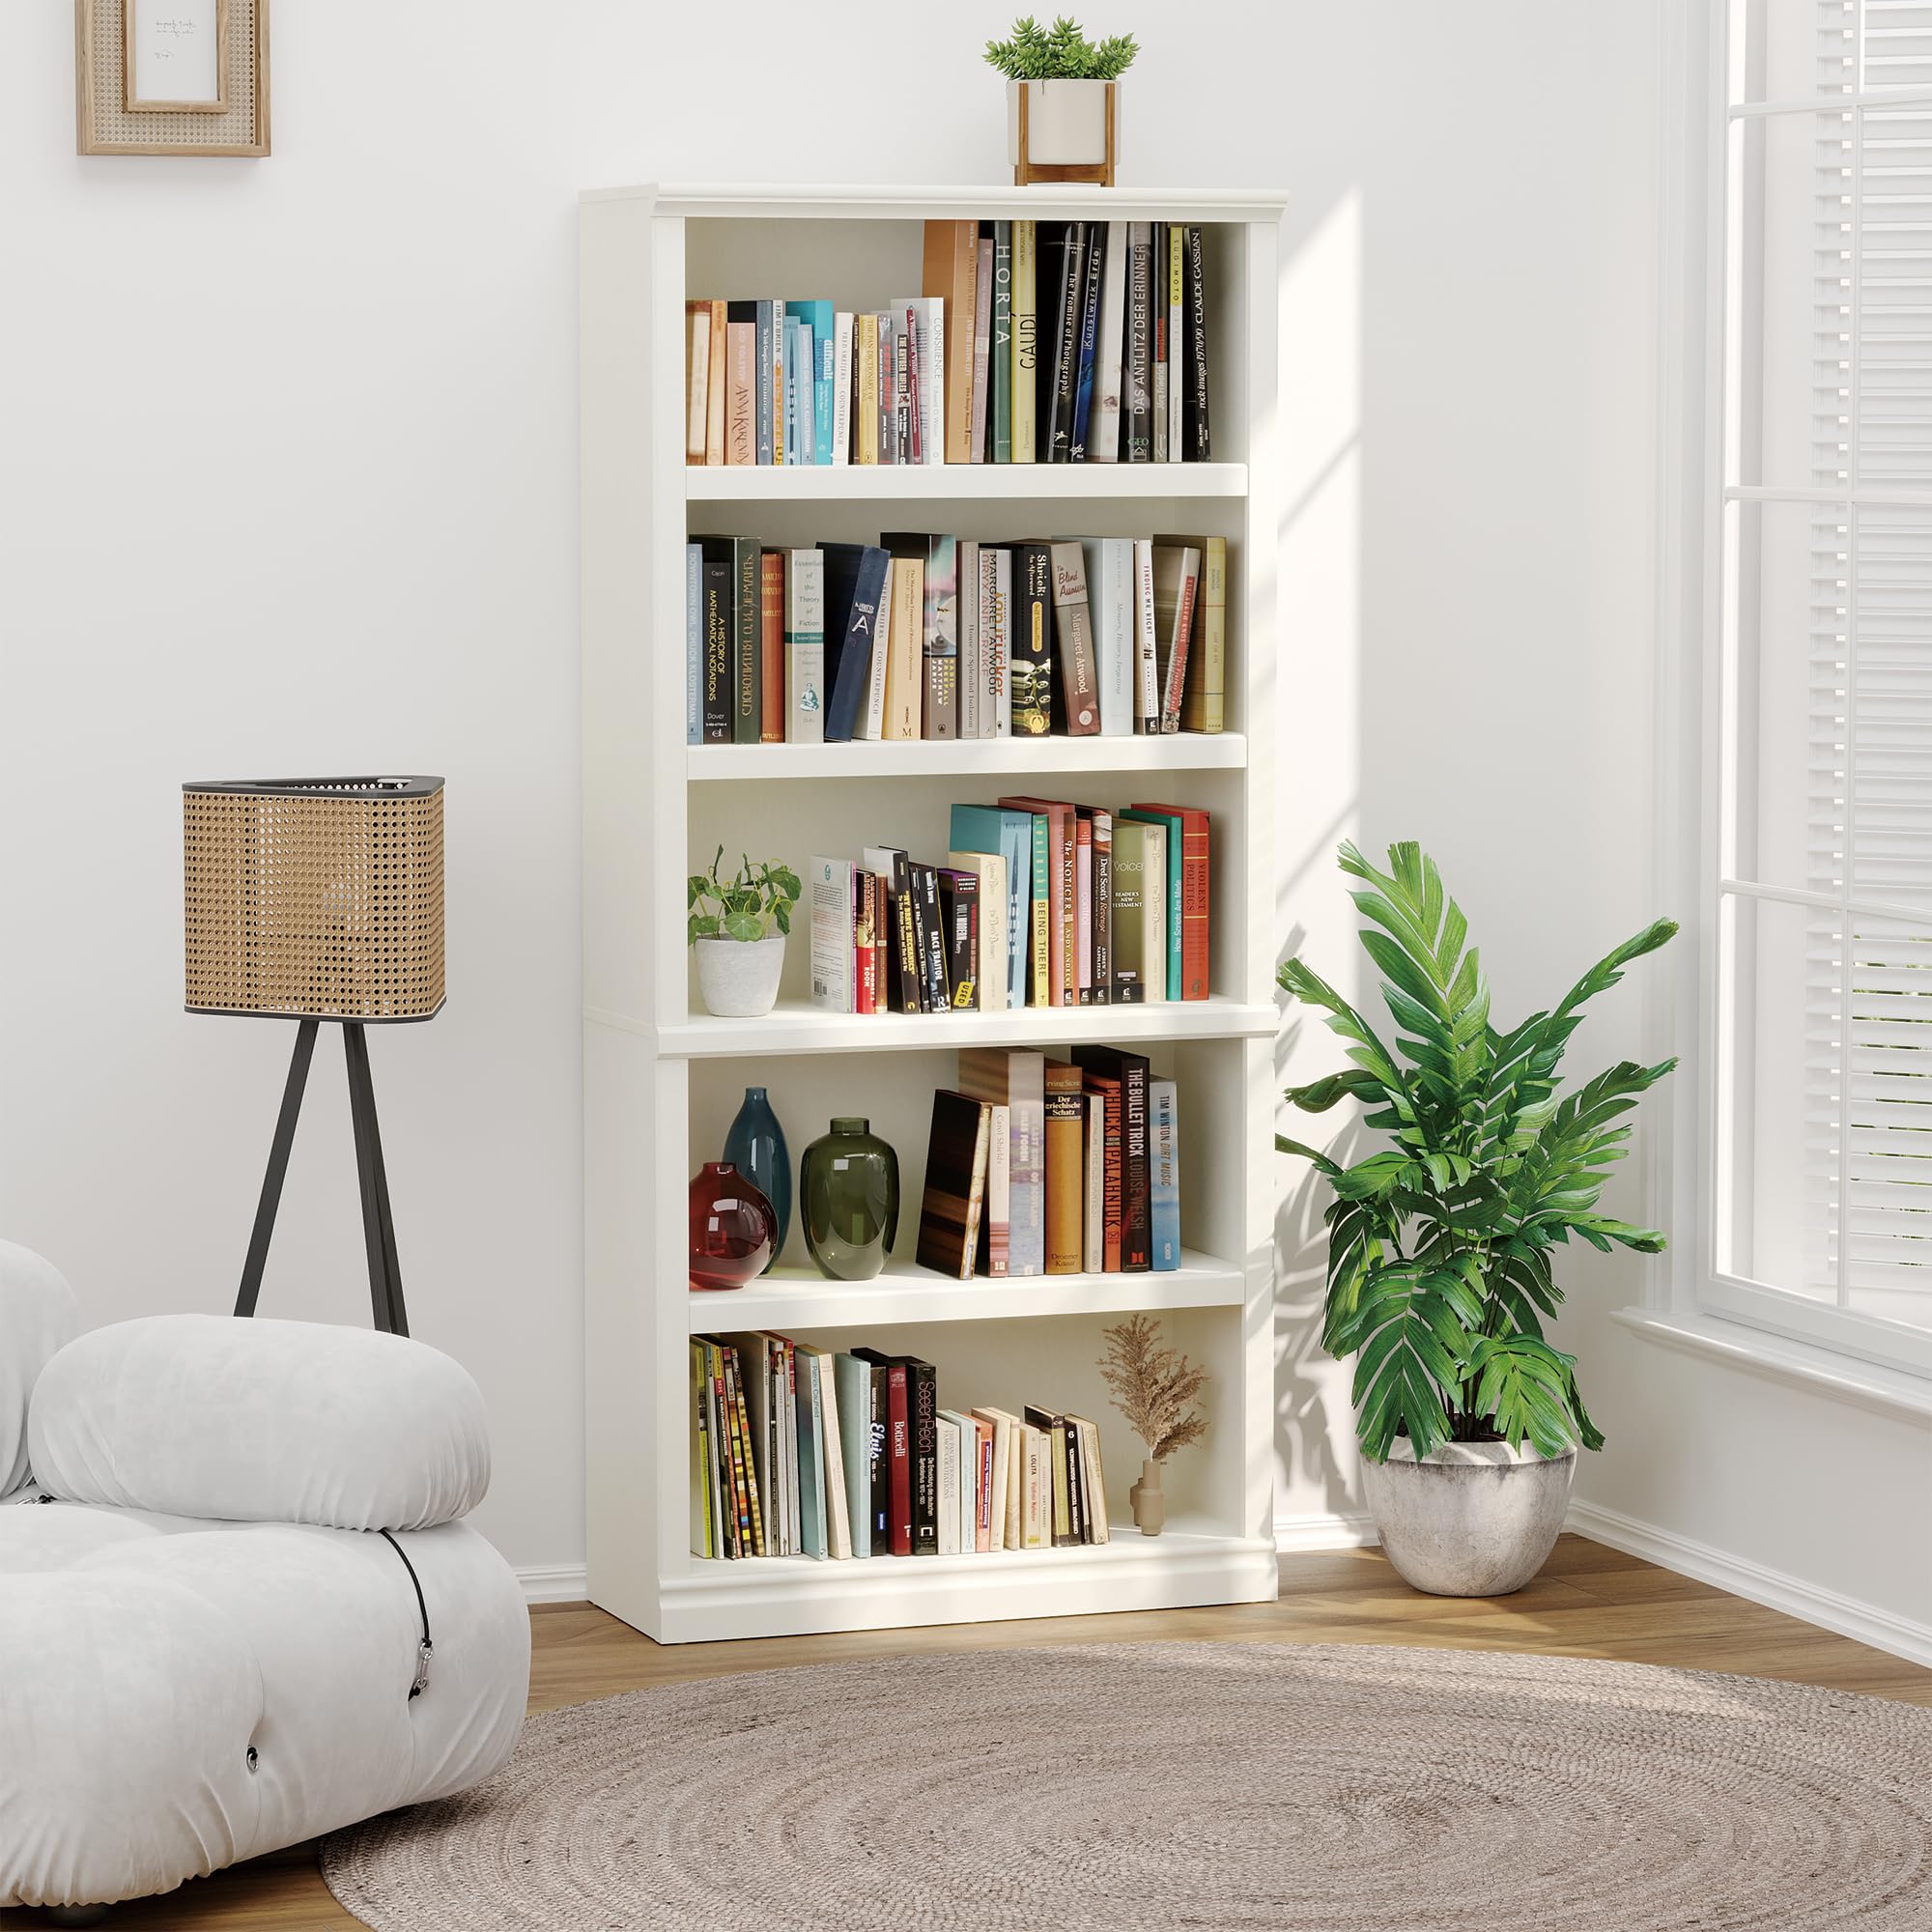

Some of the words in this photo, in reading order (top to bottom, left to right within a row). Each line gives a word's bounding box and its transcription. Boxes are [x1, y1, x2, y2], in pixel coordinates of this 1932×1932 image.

[1192, 233, 1202, 278] GASSIAN
[996, 245, 1010, 345] HORTA
[1068, 272, 1077, 289] The
[1065, 291, 1076, 326] Promise
[1083, 286, 1097, 347] Kunstwerk
[1090, 250, 1100, 280] Erde
[1194, 282, 1204, 324] CLAUDE
[1065, 328, 1073, 338] of
[1134, 304, 1145, 331] DER
[898, 336, 907, 348] THE
[933, 317, 943, 379] CONSILIENCE
[1059, 340, 1072, 396] Photography
[1134, 332, 1145, 385] ANTLITZ
[1196, 361, 1207, 388] images
[898, 373, 907, 393] RIFLES
[1134, 389, 1145, 414] DAS
[980, 554, 989, 587] ORYX
[1036, 554, 1047, 597] Shriek:
[800, 596, 820, 605] Theory
[708, 589, 717, 653] MATHEMATICAL
[877, 603, 887, 639] SMEIJERS
[1071, 613, 1083, 655] Margaret
[717, 627, 725, 661] HISTORY
[708, 655, 717, 701] NOTATIONS
[717, 663, 724, 674] OF
[872, 651, 883, 715] COUNTERPUNCH
[1076, 657, 1089, 694] Atwood
[1064, 839, 1072, 855] The
[1099, 858, 1108, 877] Dred
[1113, 860, 1144, 872] voice
[1064, 860, 1073, 909] NOTICER
[1099, 877, 1108, 900] Scott's
[1186, 864, 1195, 912] POLITICS
[1197, 864, 1207, 911] VIOLENT
[1080, 892, 1090, 924] control
[1098, 902, 1107, 933] Revenge
[930, 930, 941, 950] RACE
[932, 950, 943, 980] TRAITOR
[1037, 941, 1046, 977] THERE
[957, 984, 970, 1004] USED
[1128, 1068, 1144, 1088] THE
[1104, 1087, 1121, 1132] CHUCK
[1128, 1089, 1144, 1125] BULLET
[1159, 1095, 1170, 1110] TIM
[996, 1114, 1005, 1135] Carol
[1160, 1112, 1171, 1141] WINTON
[996, 1137, 1005, 1164] Shields
[1019, 1134, 1029, 1162] FODEN
[1128, 1126, 1144, 1156] TRICK
[1161, 1143, 1171, 1159] DIRT
[1030, 1172, 1038, 1182] OF
[1104, 1150, 1121, 1228] PALAHNIUK
[1129, 1158, 1144, 1193] LOUISE
[1161, 1162, 1172, 1186] MUSIC
[1129, 1196, 1144, 1230] WELSH
[918, 1381, 935, 1453] SeelenReich
[869, 1422, 885, 1460] Elvis
[894, 1421, 906, 1458] Botticelli
[925, 1464, 934, 1488] Entwicklung
